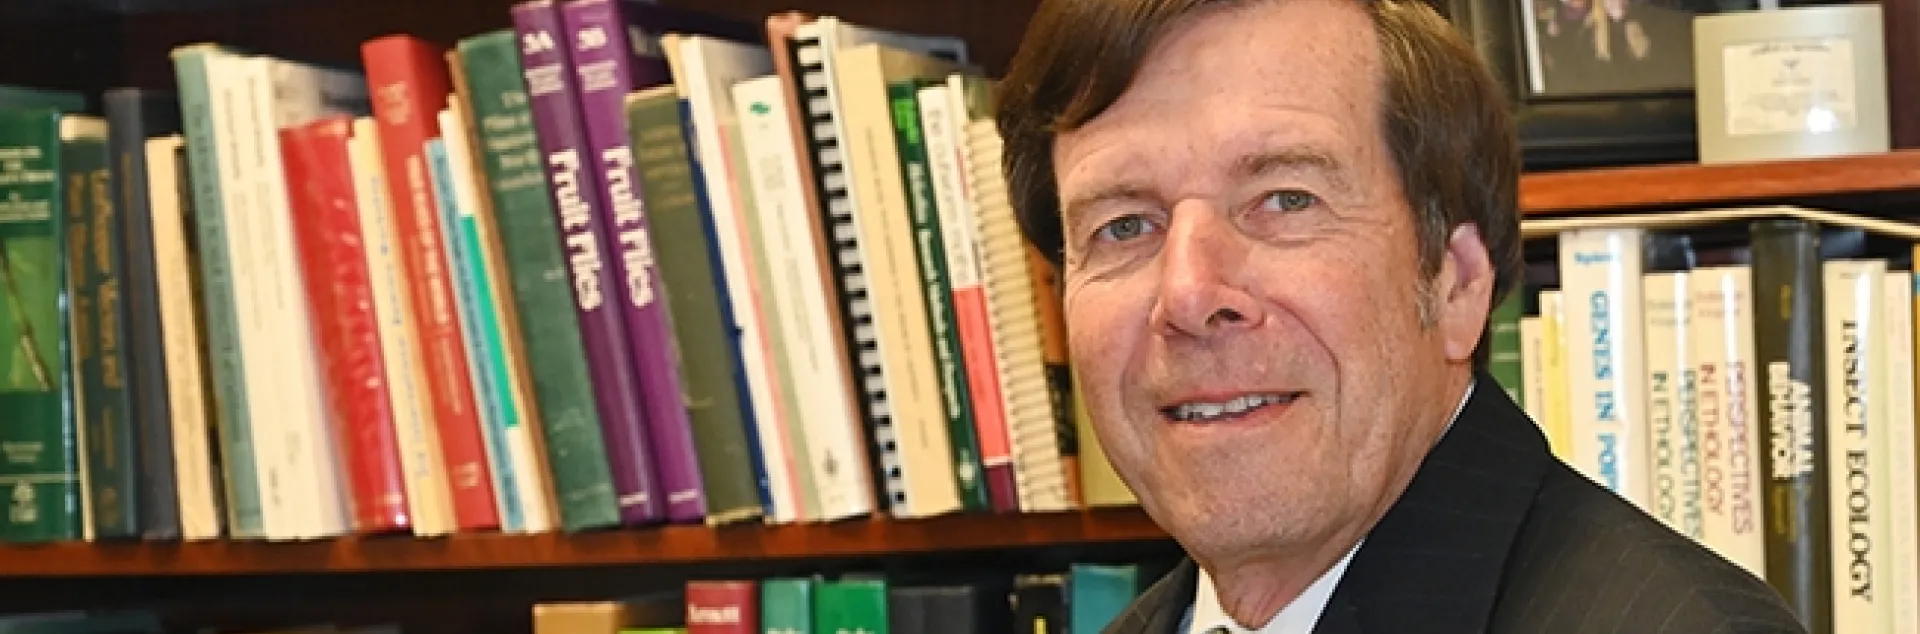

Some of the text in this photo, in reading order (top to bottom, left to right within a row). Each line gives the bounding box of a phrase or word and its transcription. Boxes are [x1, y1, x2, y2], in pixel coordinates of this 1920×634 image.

[549, 149, 603, 312] Fruit Flies
[602, 146, 655, 308] Fruit Flies
[1590, 291, 1613, 380] GENES
[1595, 391, 1616, 421] IN
[1701, 390, 1725, 516] ETHOLOGY
[1726, 361, 1755, 535] PERSPECTIVES
[1843, 320, 1873, 603] INSECT ECOLOGY
